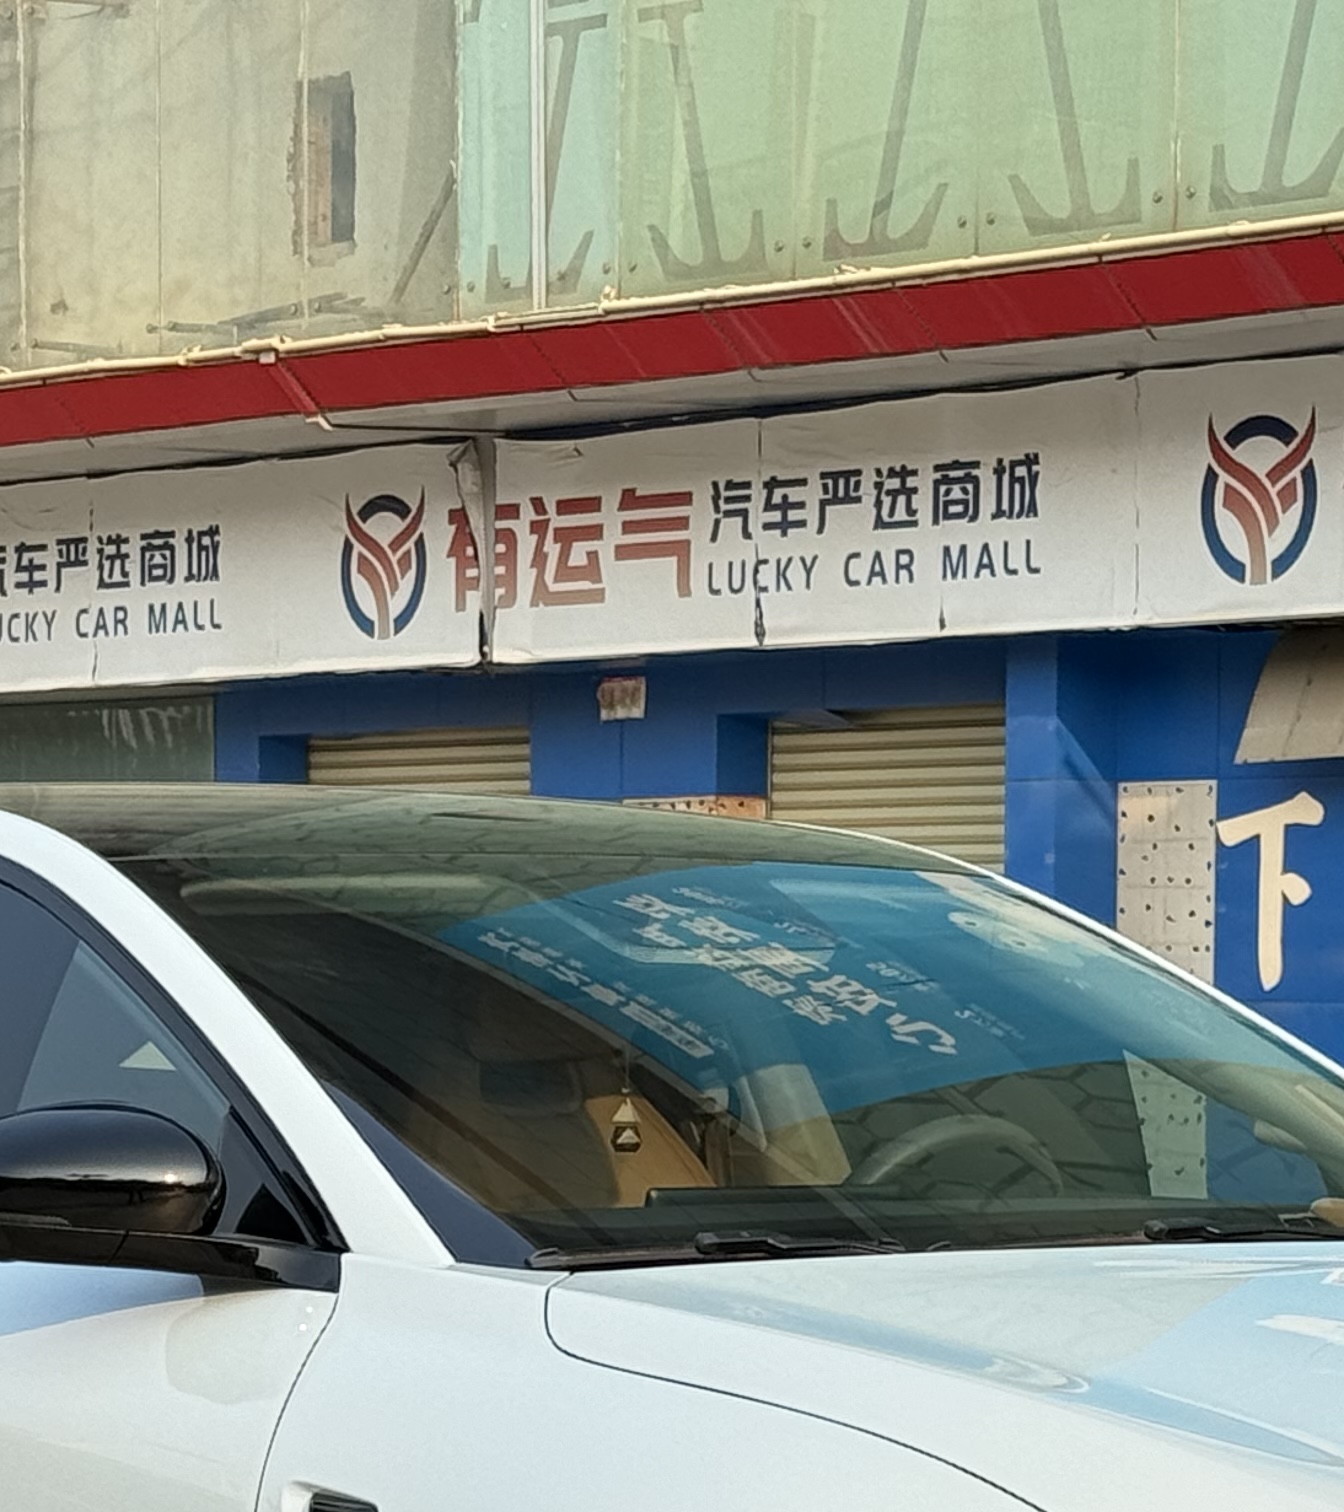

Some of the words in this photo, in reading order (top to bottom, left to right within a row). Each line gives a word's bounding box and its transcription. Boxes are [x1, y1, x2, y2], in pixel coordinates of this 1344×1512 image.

[709, 452, 1041, 544] 汽车严选商城
[446, 488, 693, 613] 有运气
[707, 554, 819, 597] LUCKY
[843, 549, 915, 587] CAR
[942, 539, 1041, 582] MALL
[75, 605, 129, 639] CAR
[147, 599, 222, 635] MALL
[1215, 791, 1324, 991] 下
